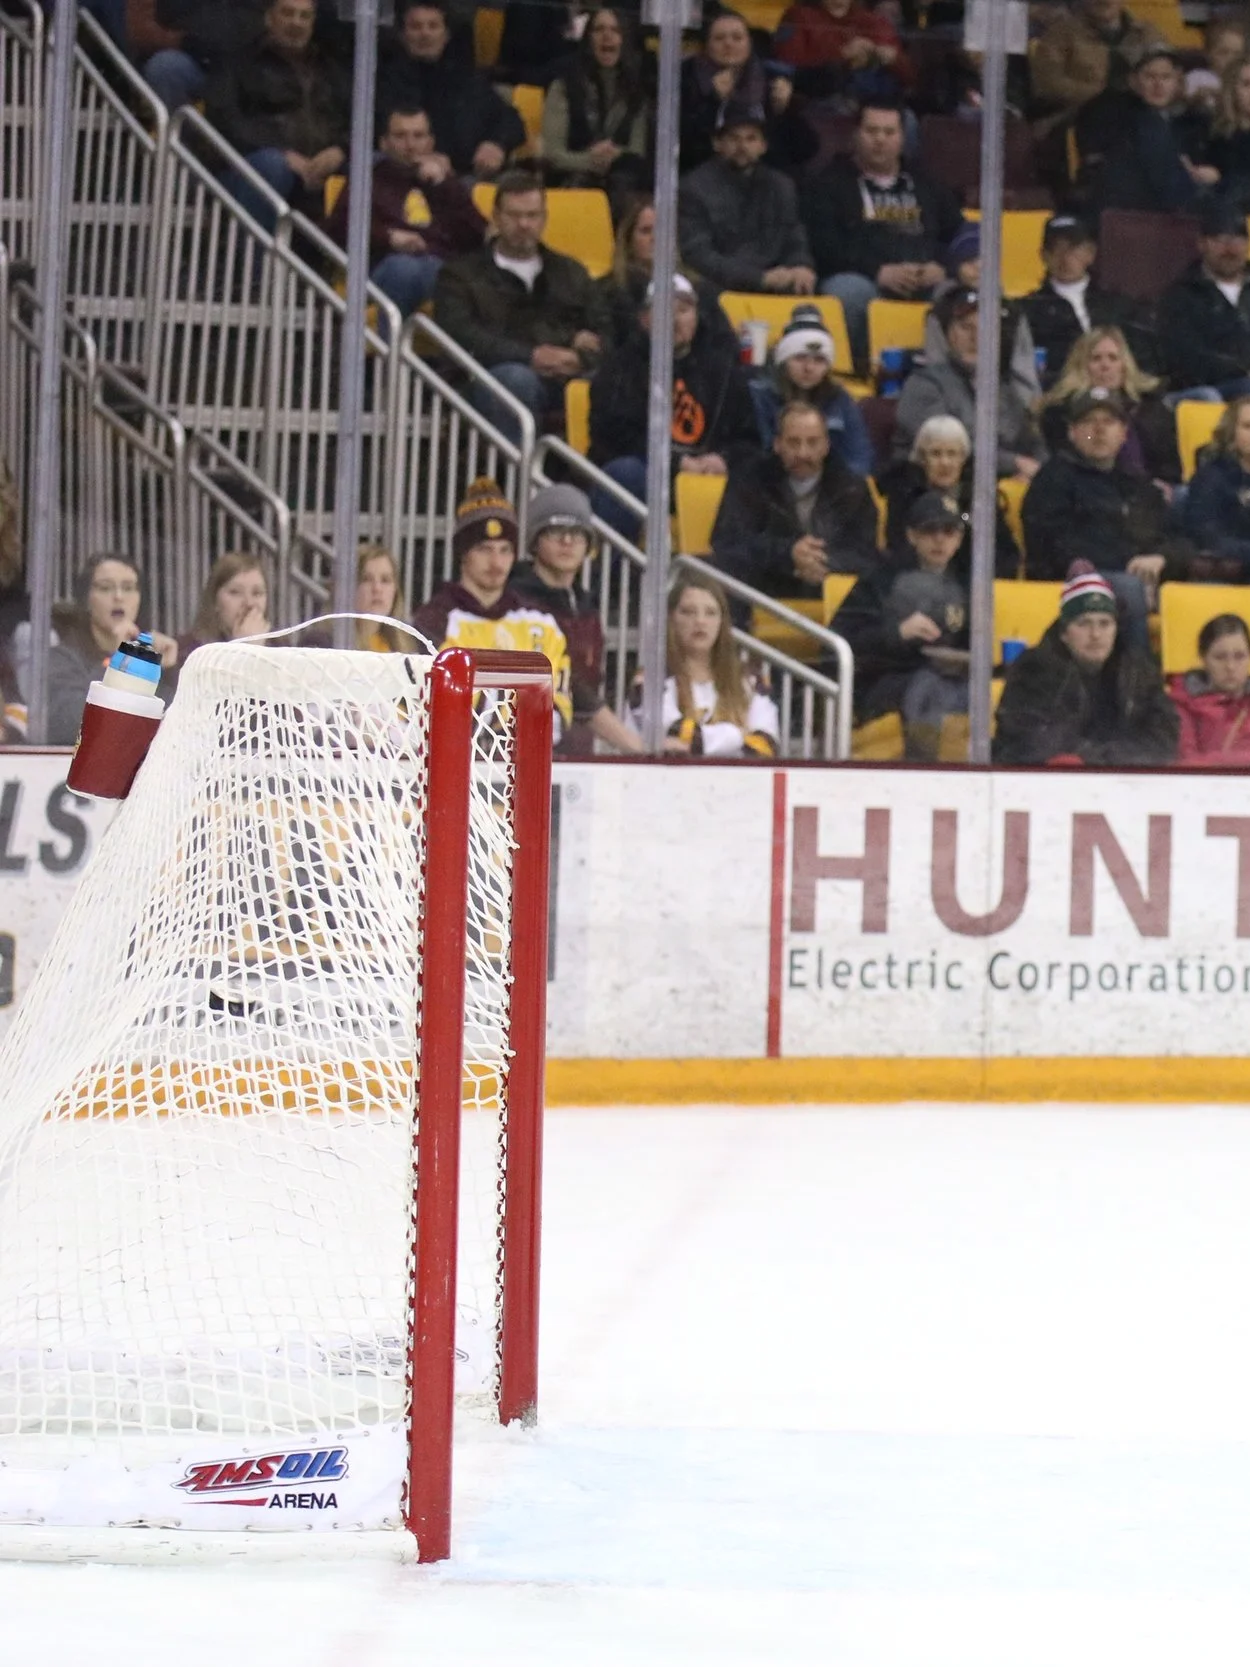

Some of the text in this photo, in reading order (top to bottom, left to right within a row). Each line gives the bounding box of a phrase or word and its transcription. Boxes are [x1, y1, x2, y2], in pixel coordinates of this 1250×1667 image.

[788, 950, 963, 991] Electric
[177, 1449, 346, 1493] AMSOIL
[268, 1492, 339, 1510] ARENA
